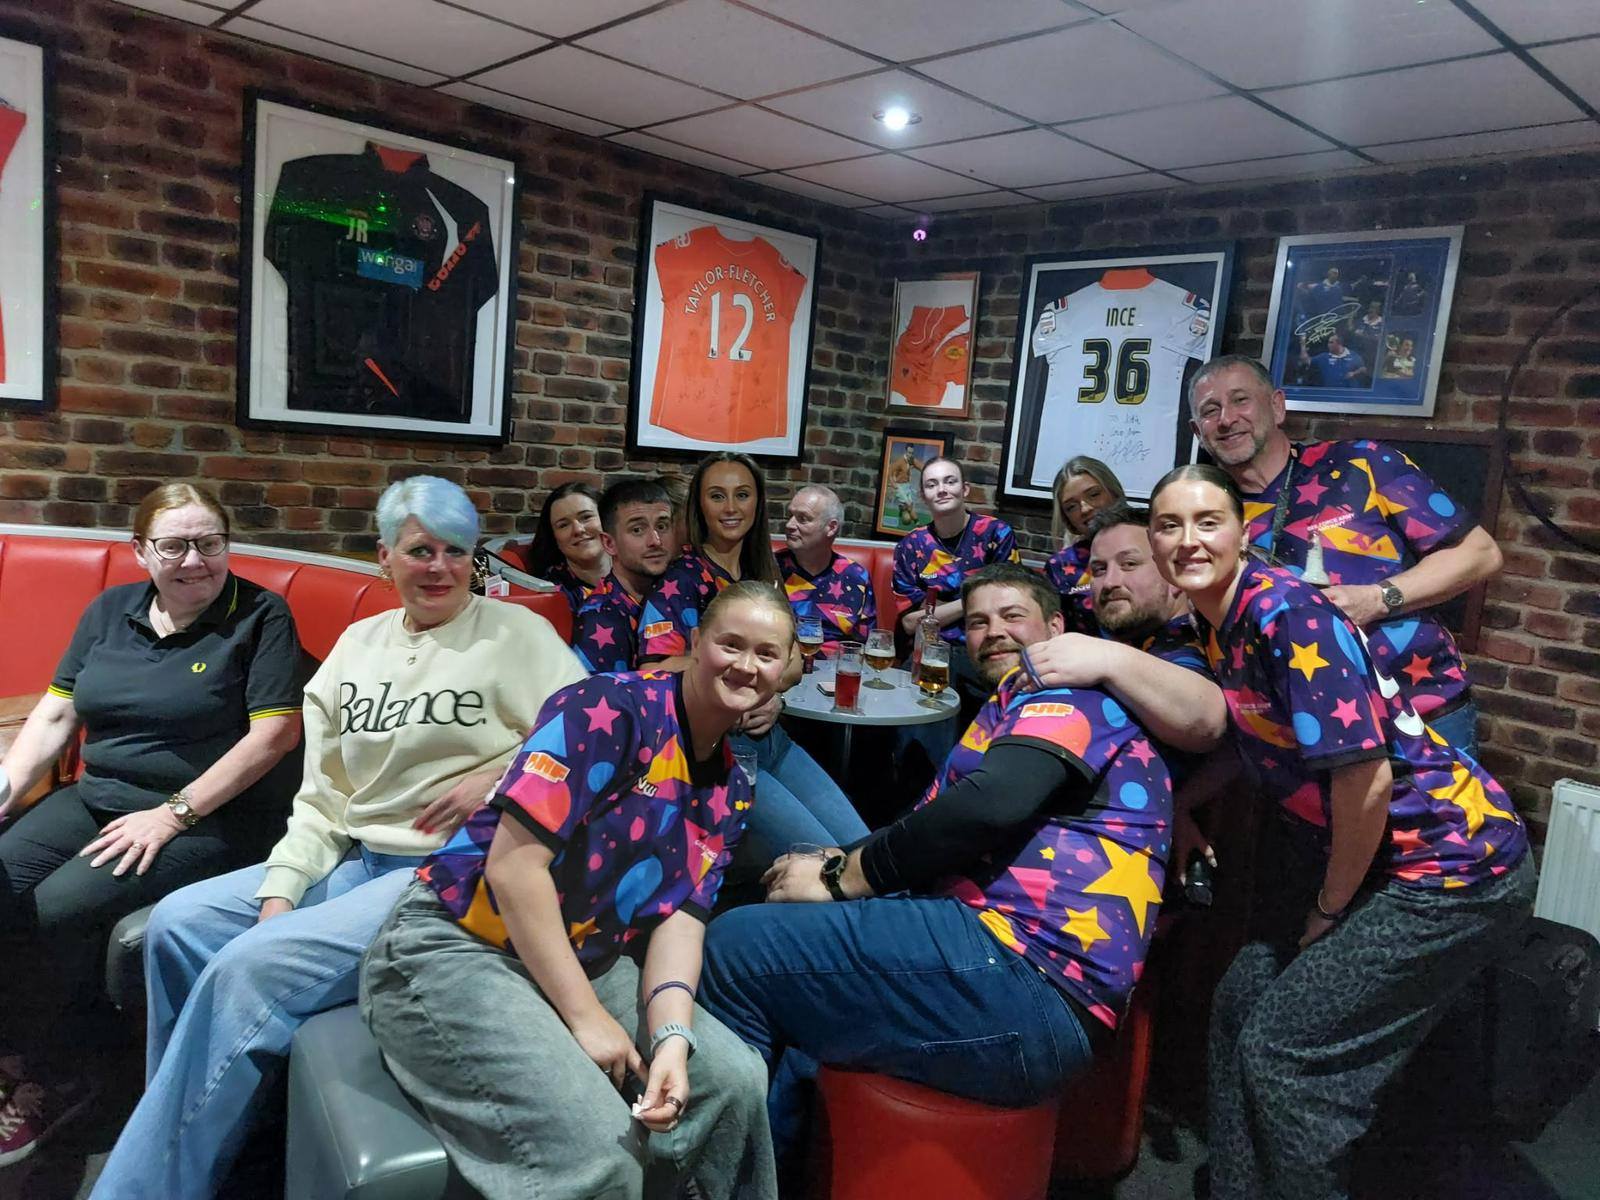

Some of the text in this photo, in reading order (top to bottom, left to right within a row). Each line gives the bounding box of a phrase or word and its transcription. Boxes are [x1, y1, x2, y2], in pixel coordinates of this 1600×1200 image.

[346, 217, 369, 243] JR
[684, 264, 776, 322] TAYLOR-FLETCHER
[1105, 307, 1136, 327] INCE
[707, 291, 754, 361] 12
[1077, 338, 1152, 405] 36
[340, 681, 486, 735] Balance.
